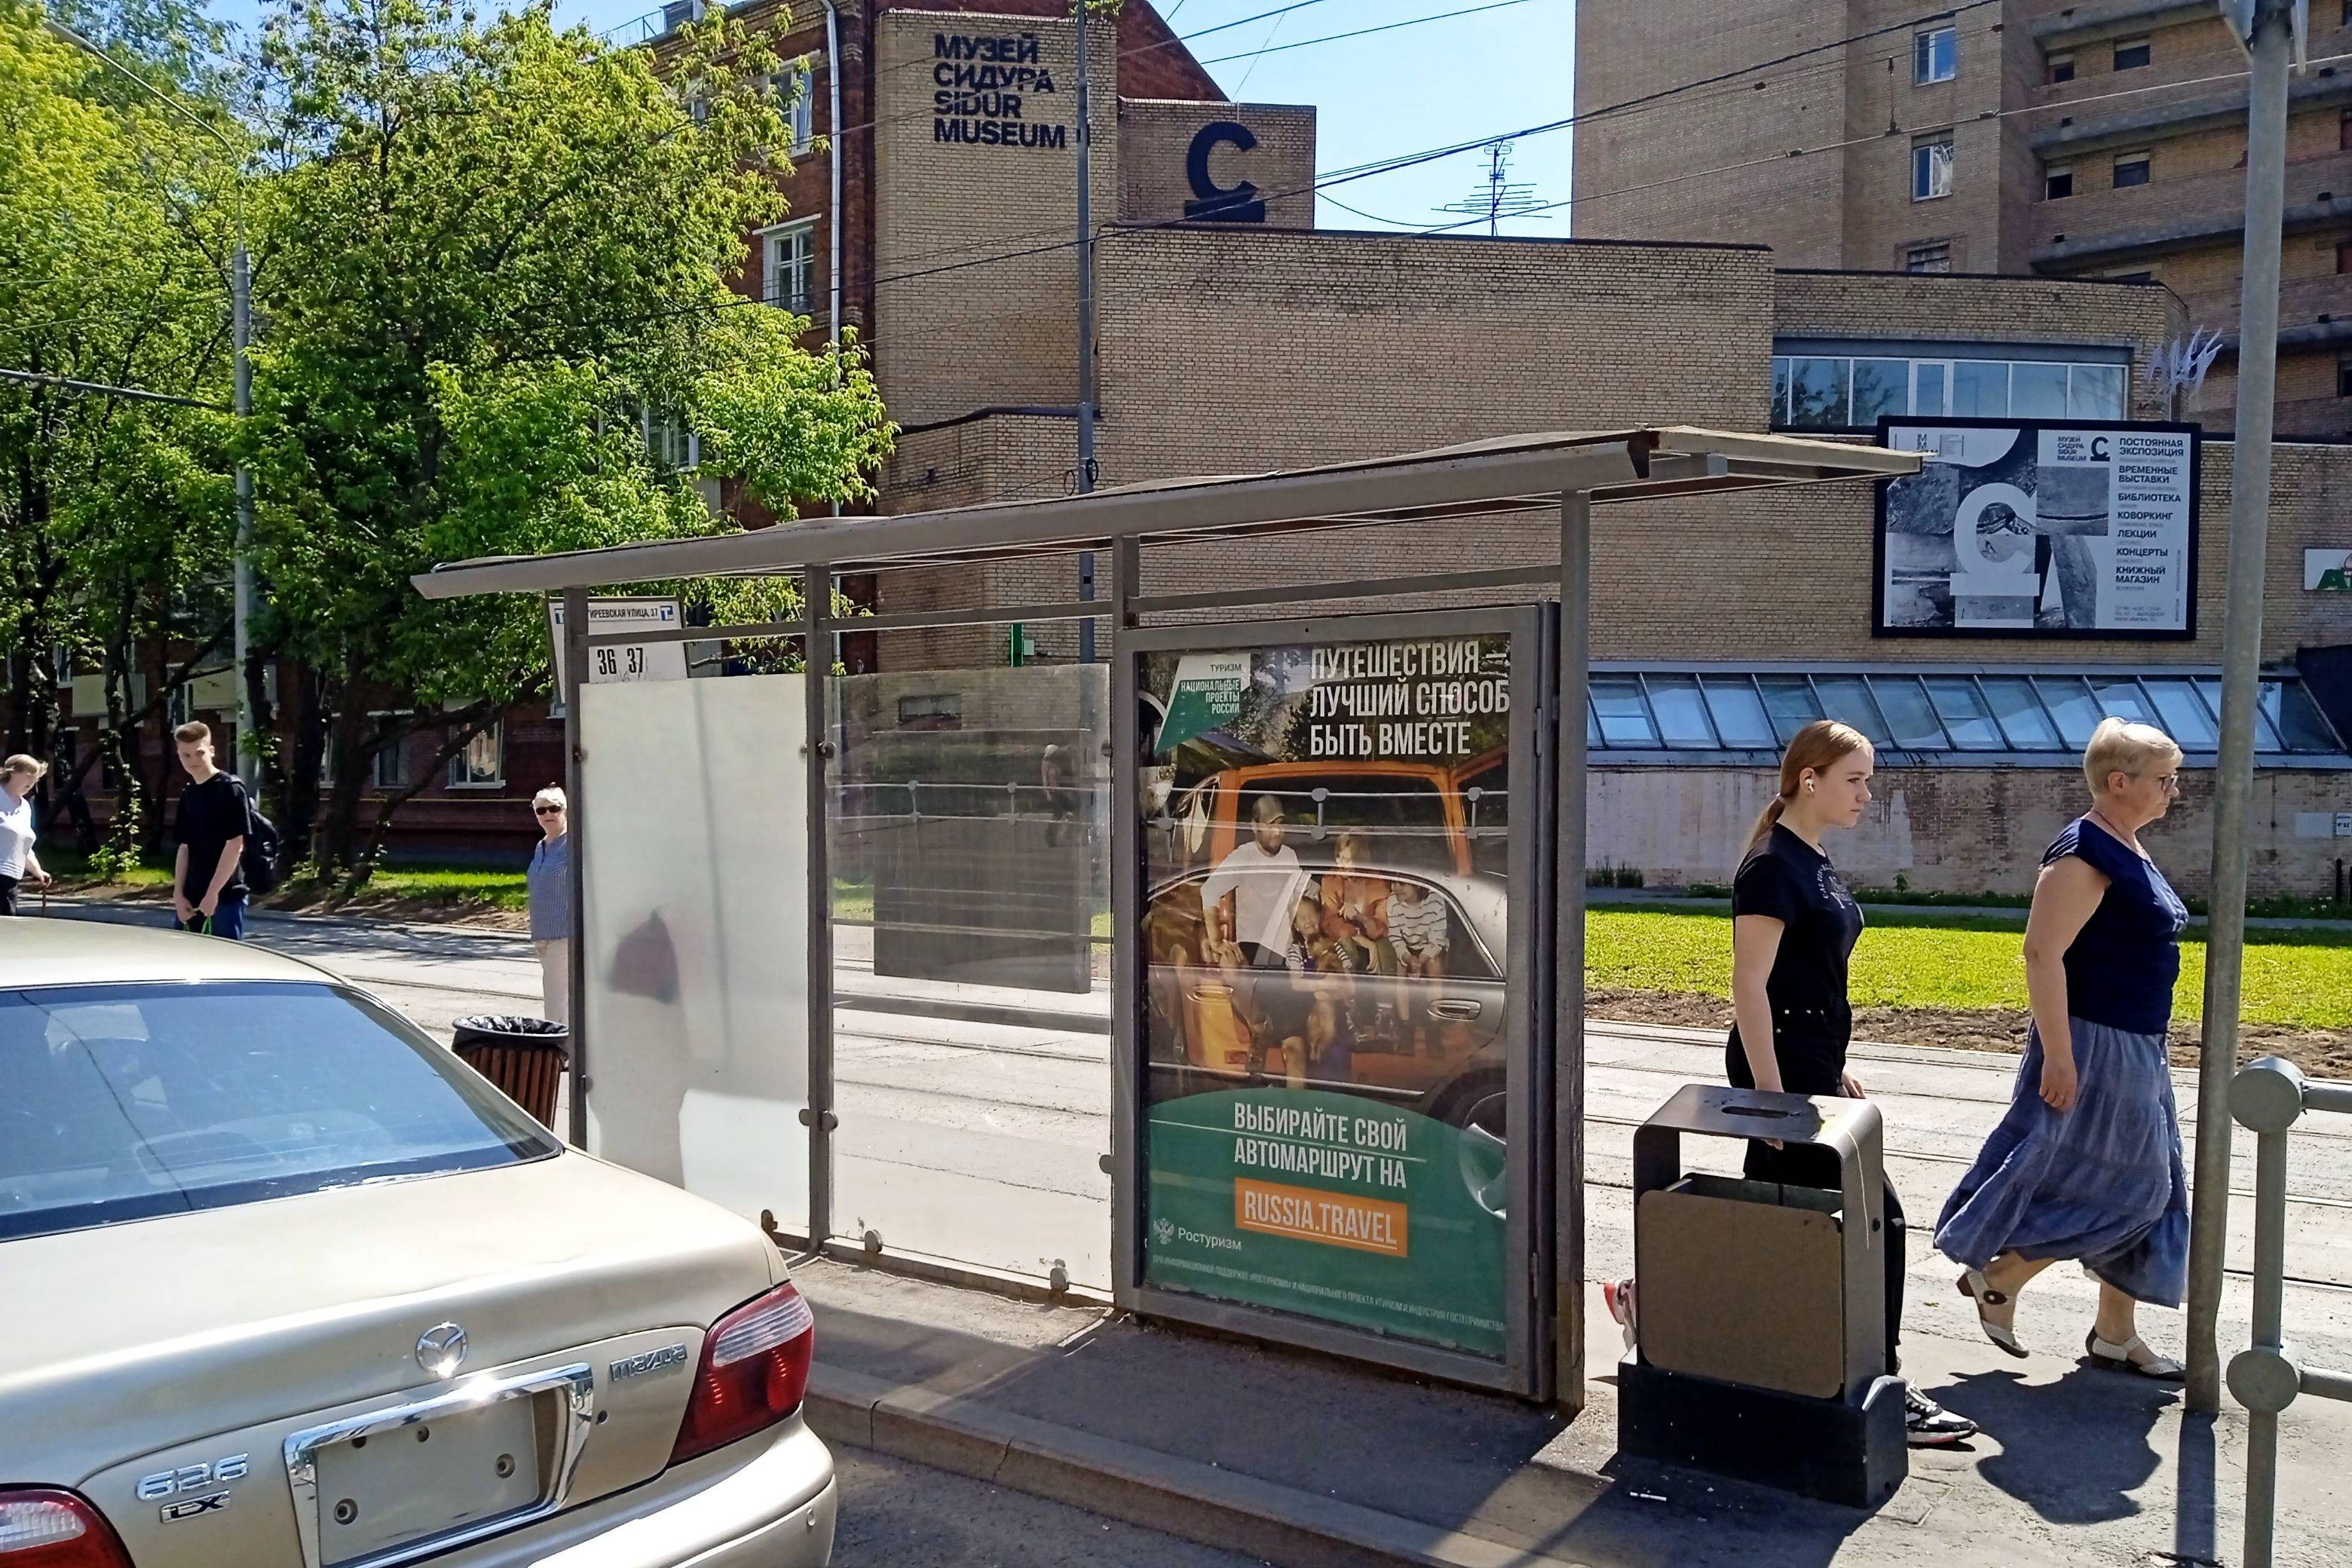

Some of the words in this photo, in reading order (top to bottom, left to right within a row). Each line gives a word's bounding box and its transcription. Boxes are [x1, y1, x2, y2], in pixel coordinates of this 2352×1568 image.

[935, 33, 1038, 63] МУЗЕЙ
[933, 63, 1055, 93] СИДУРА
[934, 90, 1021, 118] SIDUR
[934, 118, 1065, 149] MUSEUM
[2119, 438, 2183, 448] ПОСТОЯННАЯ
[2119, 447, 2184, 457] ЭКСПОЗИЦИЯ
[2119, 465, 2178, 475] ВРЕМЕННЫЕ
[2118, 474, 2170, 483] ВЫСТАВКИ
[2118, 493, 2181, 502] БИБЛИОТЕКА
[2118, 511, 2173, 520] КОВОРКИНГ
[2117, 529, 2157, 539] ЛЕКЦИИ
[2116, 548, 2168, 557] КОНЦЕРТЫ
[2115, 565, 2166, 574] КНИЖНЫЙ
[2115, 575, 2160, 583] МАГАЗИН
[626, 608, 649, 618] УЛИЦА,
[651, 608, 658, 617] 37
[596, 648, 617, 675] 36
[626, 647, 644, 674] 37
[1310, 640, 1480, 680] ПУТЕШЕСТВИЯ
[1210, 663, 1242, 672] ТУРИЗМ
[1181, 679, 1240, 692] НАЦИОНАЛЬНЫЕ
[1205, 691, 1240, 703] ПРОЕКТЫ
[1309, 678, 1410, 718] ЛУЧШИЙ
[1416, 679, 1510, 715] СПОСОБ
[1211, 703, 1240, 714] РОССИИ
[1310, 723, 1373, 756] БЫТЬ
[1379, 721, 1471, 756] ВМЕСТЕ
[1233, 1102, 1349, 1144] ВЫБИРАЙТЕ
[1355, 1118, 1407, 1152] СВОЙ
[1233, 1137, 1373, 1184] АВТОМАРШРУТ
[1380, 1160, 1407, 1189] НА
[1244, 1190, 1398, 1245] RUSSIA.TRAVEL
[1178, 1227, 1242, 1251] Ростуризм
[136, 1451, 250, 1501] 626
